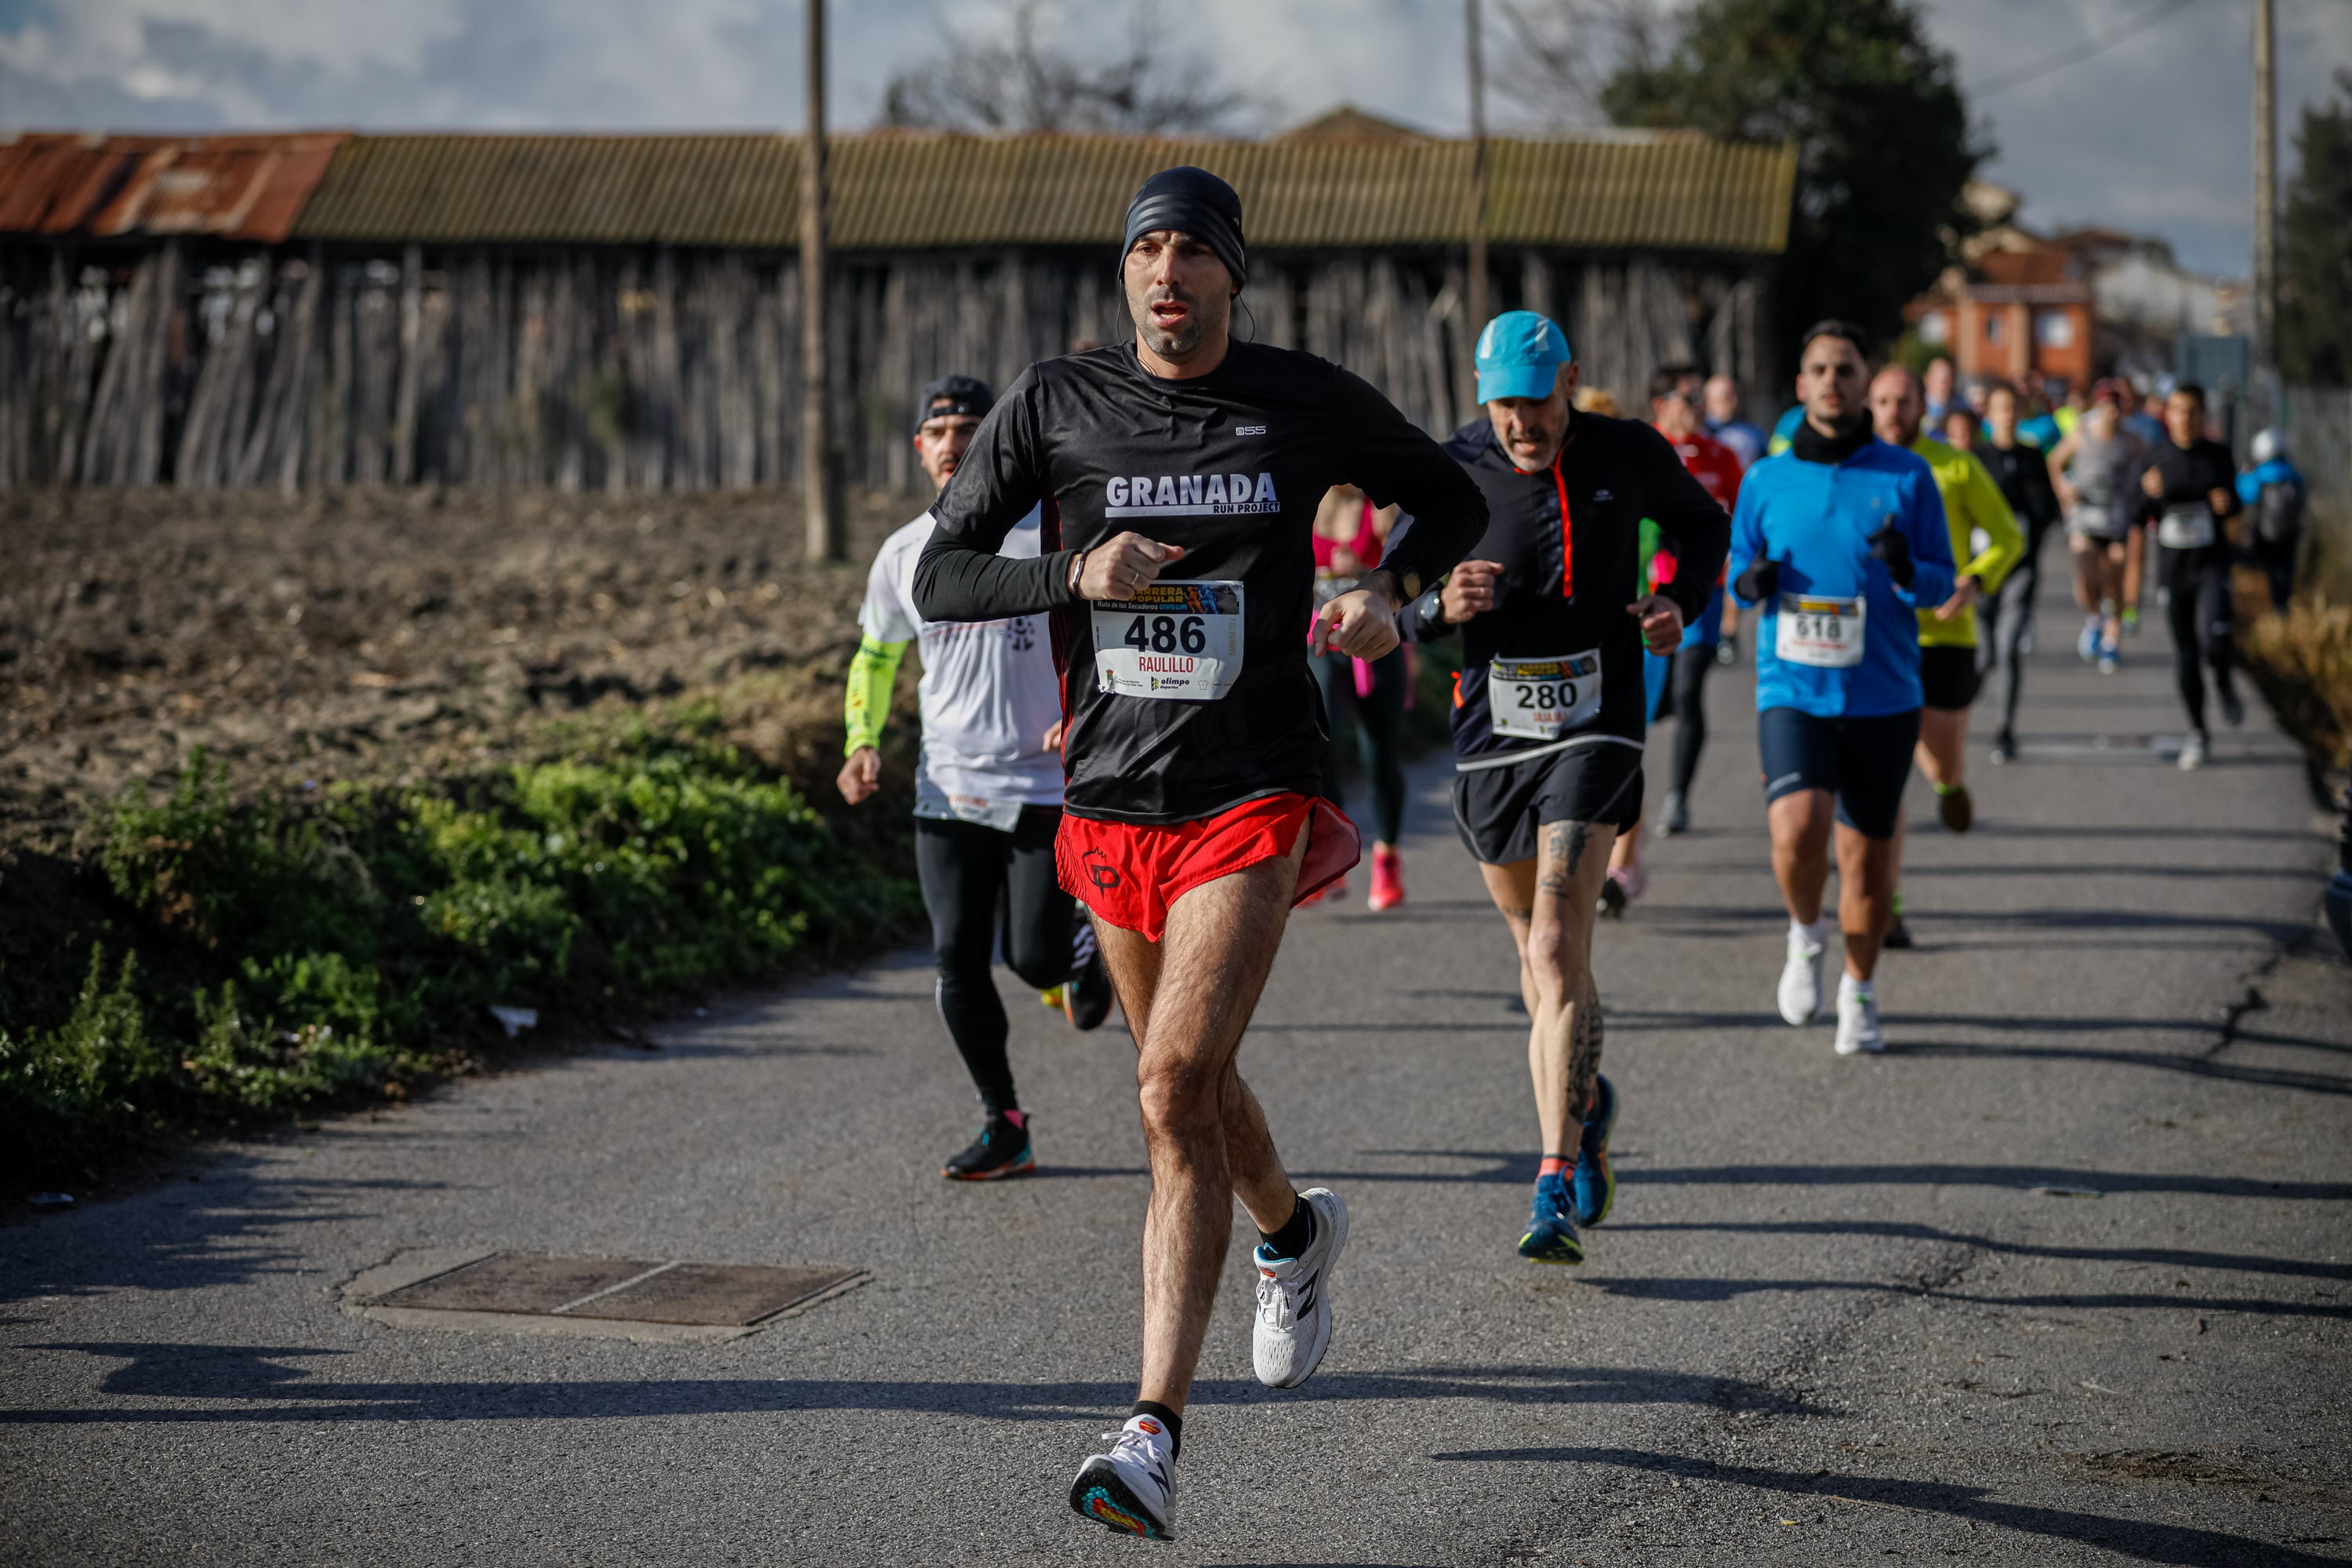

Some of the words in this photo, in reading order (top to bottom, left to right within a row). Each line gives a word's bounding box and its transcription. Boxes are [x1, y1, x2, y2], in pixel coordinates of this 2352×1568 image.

[1106, 472, 1277, 507] GRANADA
[1214, 505, 1234, 514] RUN
[1237, 502, 1279, 514] PROJECT
[1124, 615, 1206, 654] 486
[1139, 656, 1194, 673] RAULILLO
[1161, 677, 1190, 687] olimpo
[1515, 682, 1577, 710] 280
